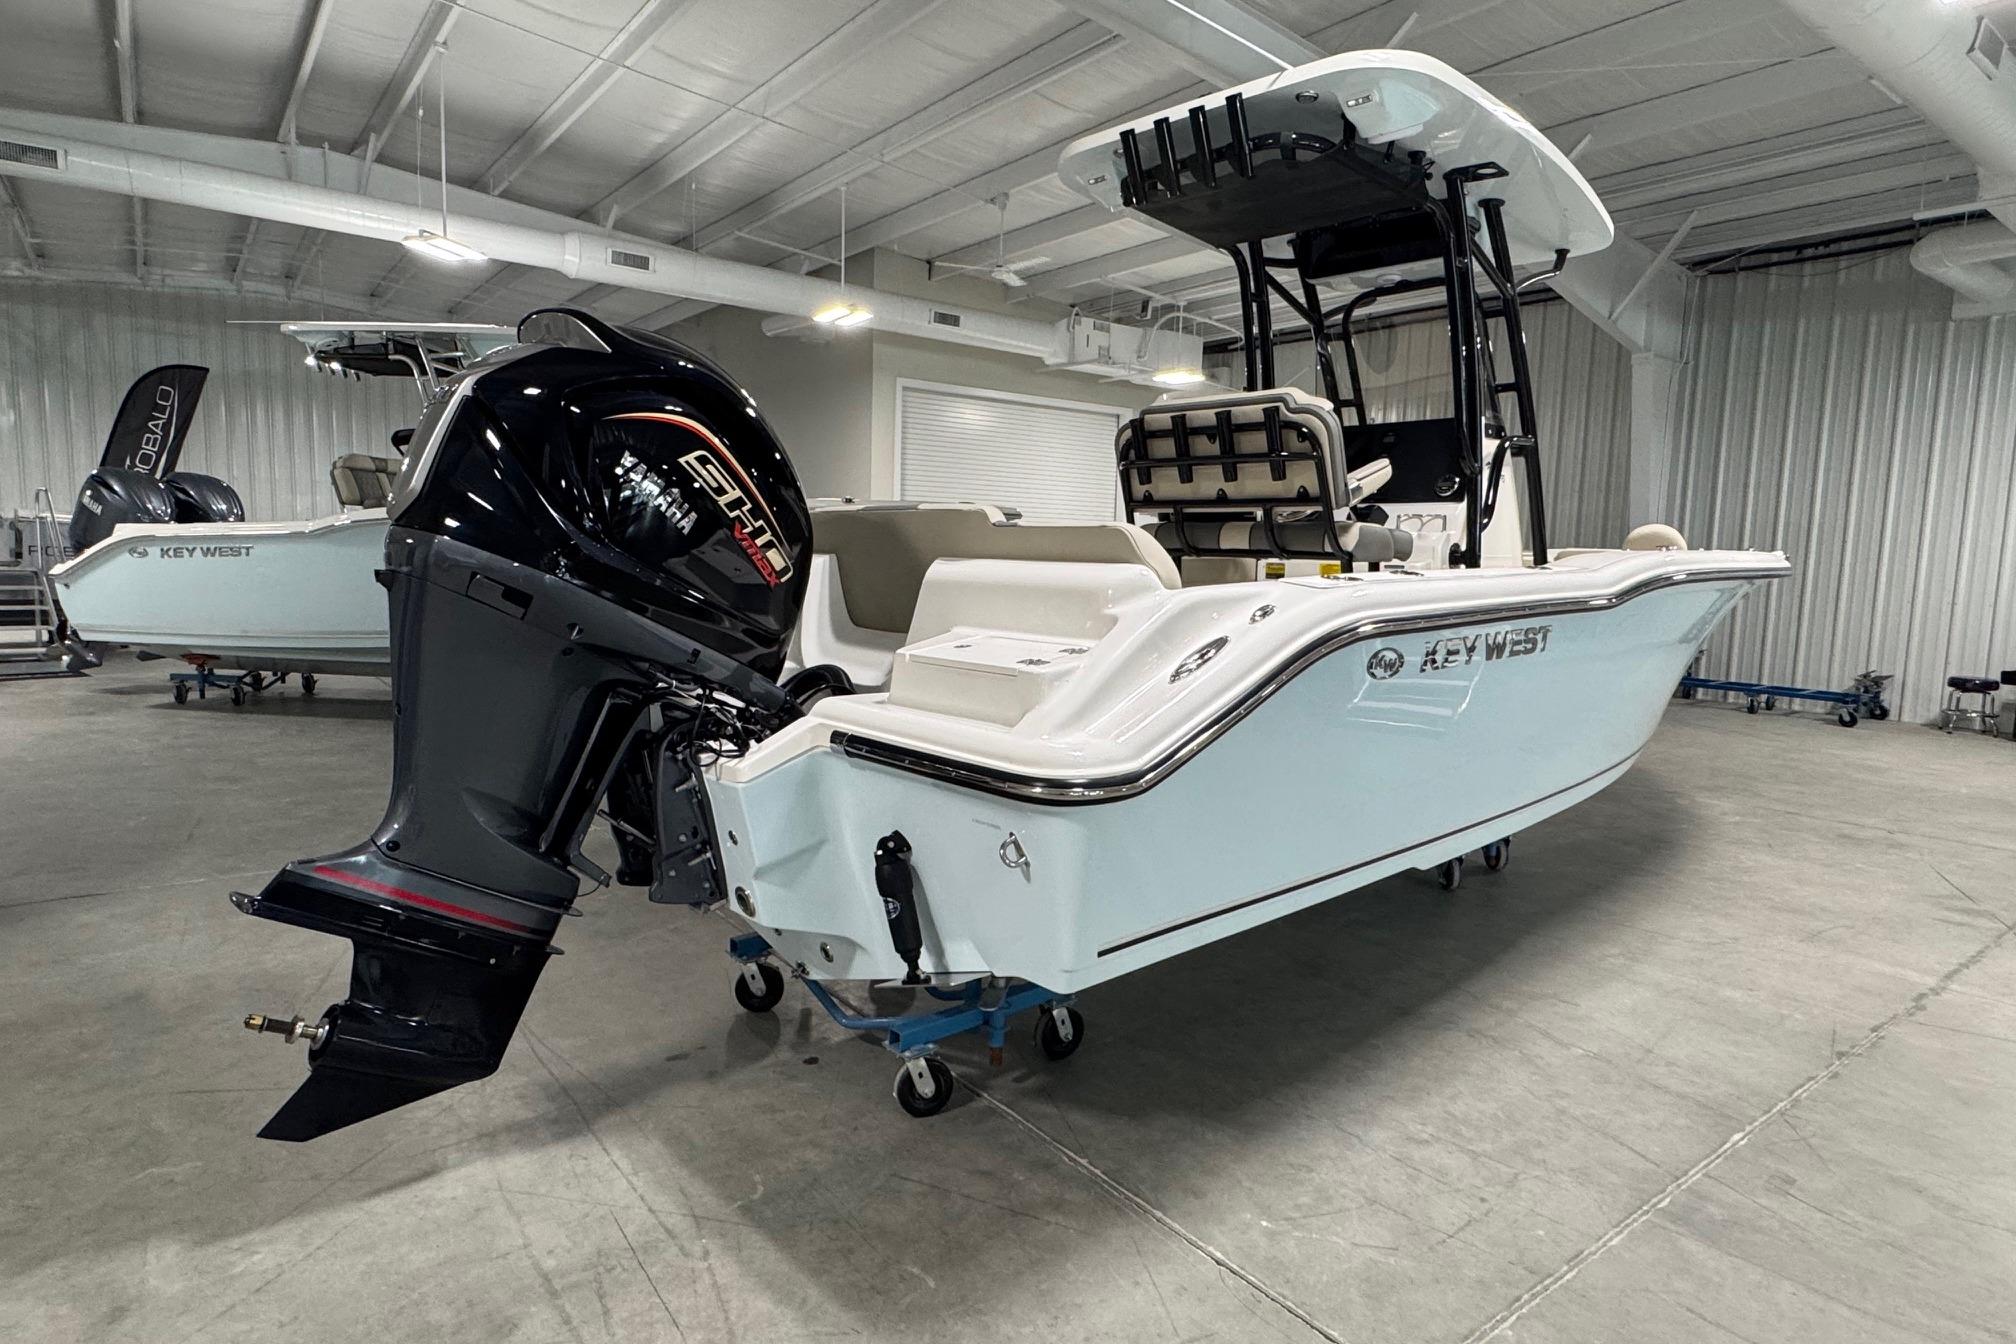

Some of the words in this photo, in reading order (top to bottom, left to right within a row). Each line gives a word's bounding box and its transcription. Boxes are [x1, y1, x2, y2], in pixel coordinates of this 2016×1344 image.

[135, 386, 174, 473] OBALO
[616, 450, 698, 536] YAMAHA
[677, 450, 794, 583] SHO
[160, 547, 197, 559] KEY
[200, 545, 254, 558] WEST
[1419, 634, 1482, 673] KEY
[1485, 625, 1552, 662] WEST
